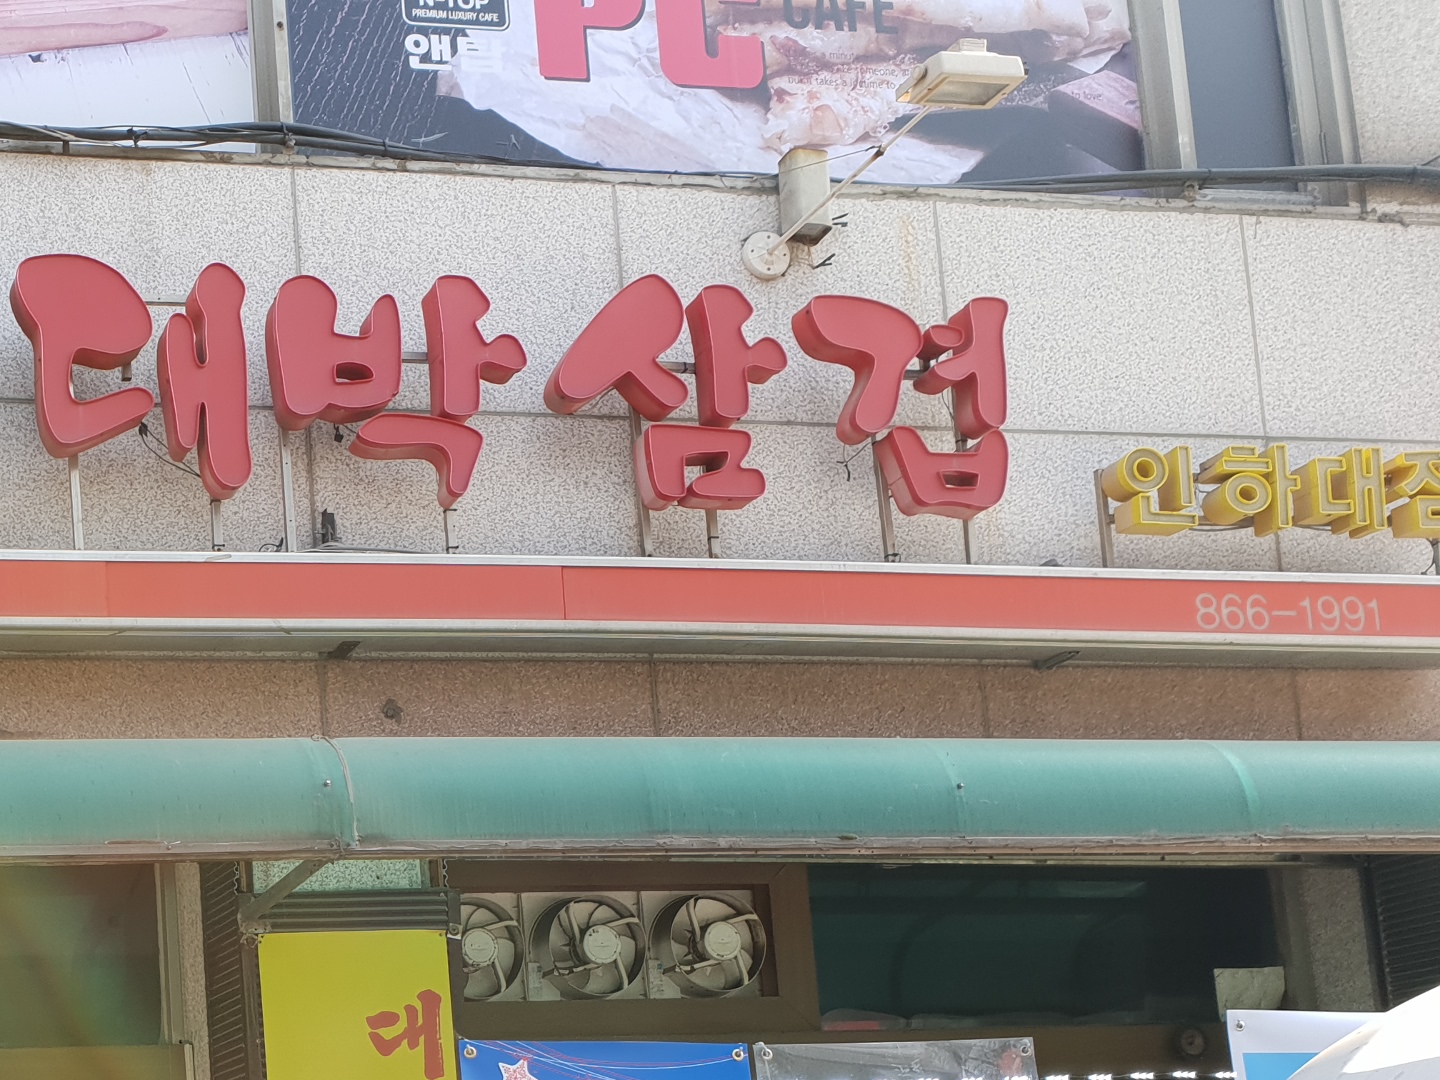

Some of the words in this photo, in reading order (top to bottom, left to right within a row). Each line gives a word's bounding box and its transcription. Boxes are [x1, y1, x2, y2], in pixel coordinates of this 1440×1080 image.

[412, 9, 448, 20] PREMIUM
[448, 10, 478, 21] LUXURY
[478, 13, 500, 22] CAFE
[784, 0, 899, 35] CAFE
[534, 0, 765, 89] PC
[10, 252, 1010, 521] 대박삼겹
[1194, 591, 1383, 632] 866-1991
